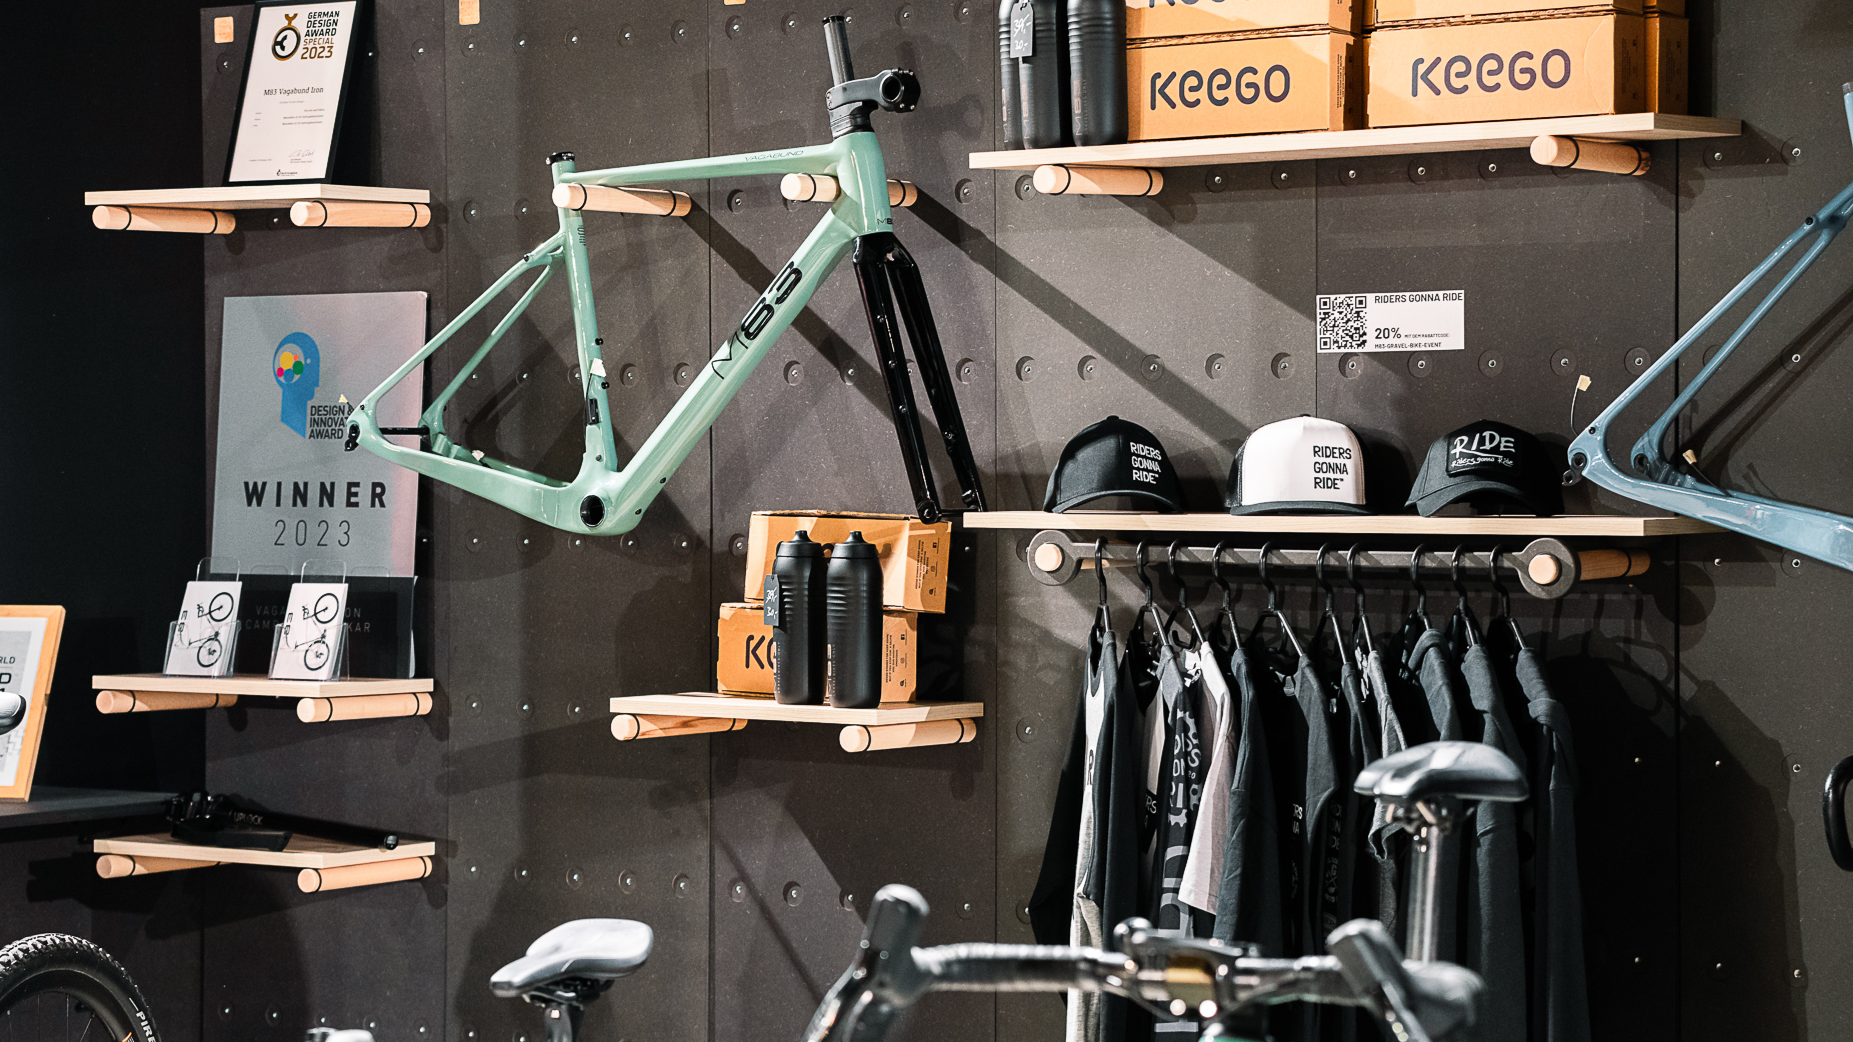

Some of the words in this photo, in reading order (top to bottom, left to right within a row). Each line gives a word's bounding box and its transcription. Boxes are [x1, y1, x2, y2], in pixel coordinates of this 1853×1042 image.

[307, 10, 340, 20] GERMAN
[306, 19, 339, 29] DESIGN
[304, 28, 337, 38] AWARD
[303, 37, 335, 46] SPECIAL
[300, 46, 333, 60] 2023
[263, 88, 278, 96] M83
[279, 87, 310, 96] Vagabund
[311, 86, 324, 94] Iron
[745, 150, 804, 162] VAGABUND
[876, 217, 893, 225] M8
[1374, 294, 1407, 304] RIDERS
[1408, 293, 1441, 303] GONNA
[1442, 292, 1463, 302] RIDE
[1374, 327, 1402, 340] 20%
[310, 405, 345, 416] DESIGN
[309, 417, 348, 428] INNOVA
[309, 429, 344, 440] AWARD
[1130, 441, 1162, 460] RIDERS
[1450, 430, 1516, 459] RIDE
[1313, 445, 1352, 460] RIDERS
[1131, 455, 1162, 473] GONNA
[1313, 461, 1349, 475] GONNA
[243, 481, 387, 508] WINNER
[273, 519, 351, 547] 2023
[136, 1011, 157, 1042] PIRE
